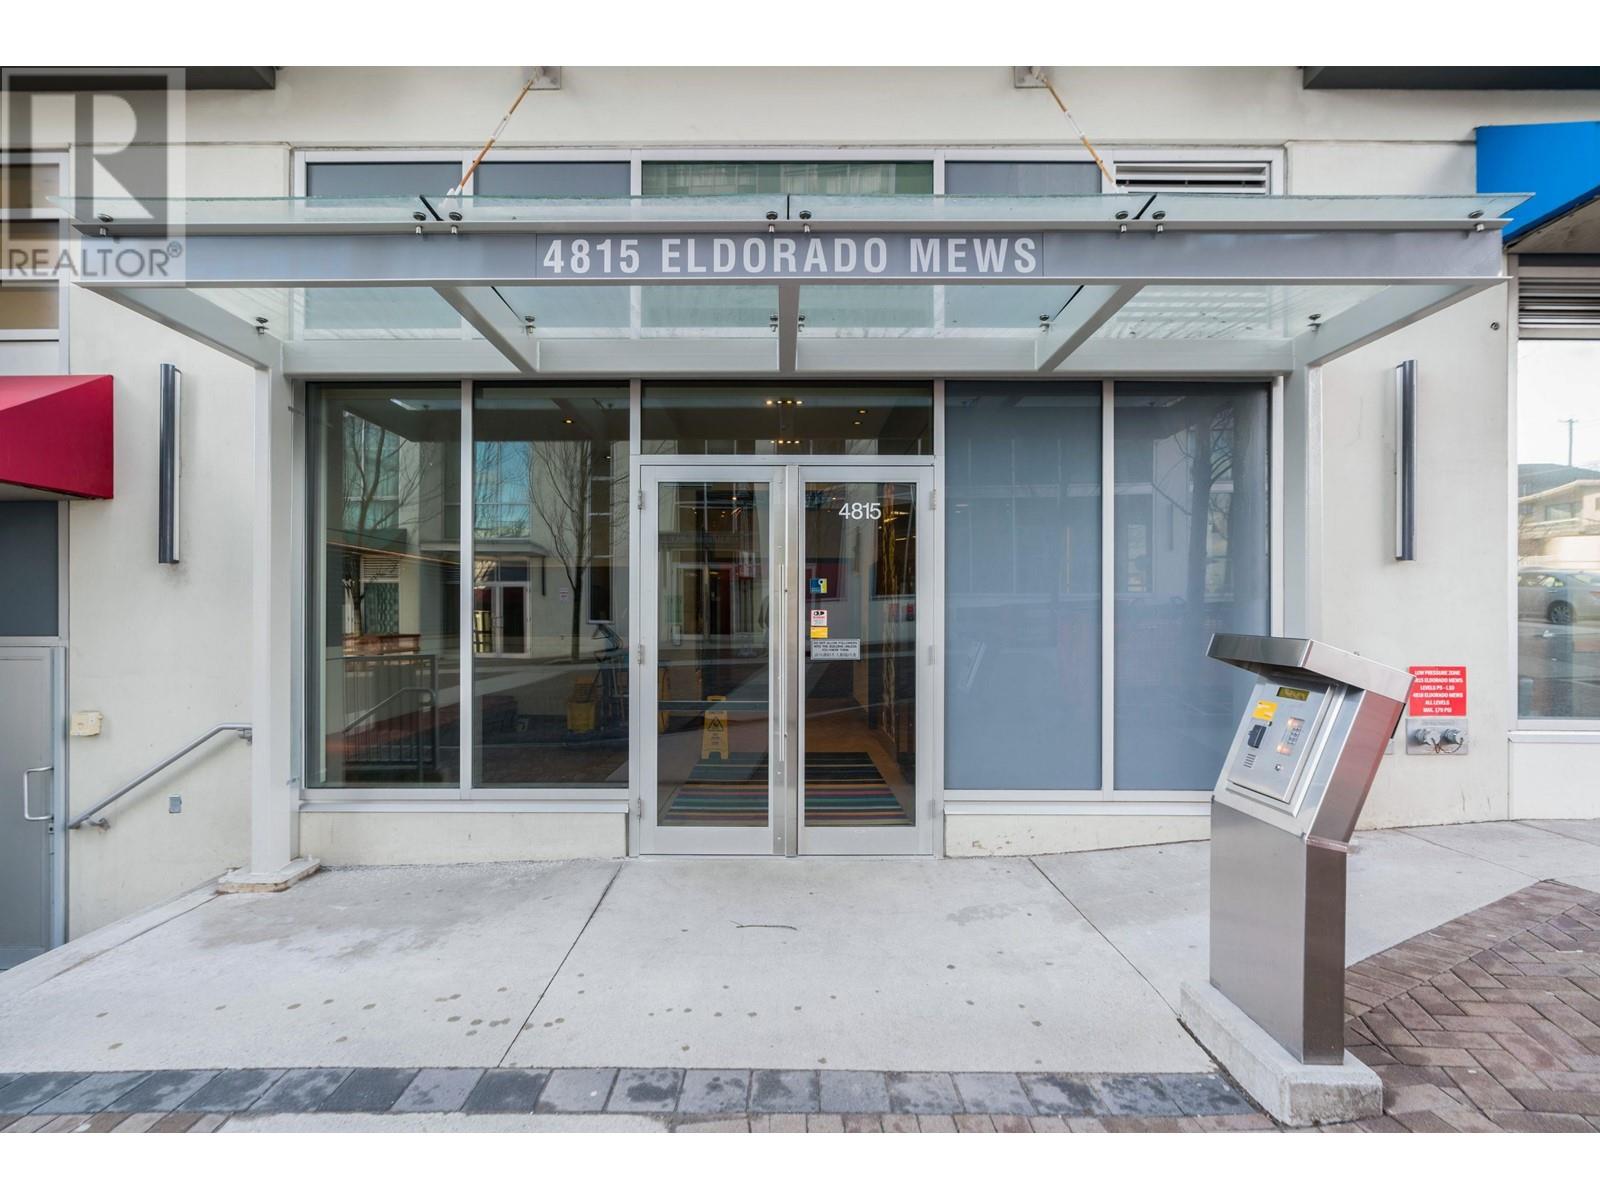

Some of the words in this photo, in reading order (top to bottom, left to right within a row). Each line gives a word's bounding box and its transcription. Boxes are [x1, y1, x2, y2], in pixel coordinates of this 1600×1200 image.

[543, 239, 640, 274] 4815
[661, 238, 888, 274] ELDORADO
[909, 237, 1037, 274] MEWS
[838, 502, 882, 520] 4815
